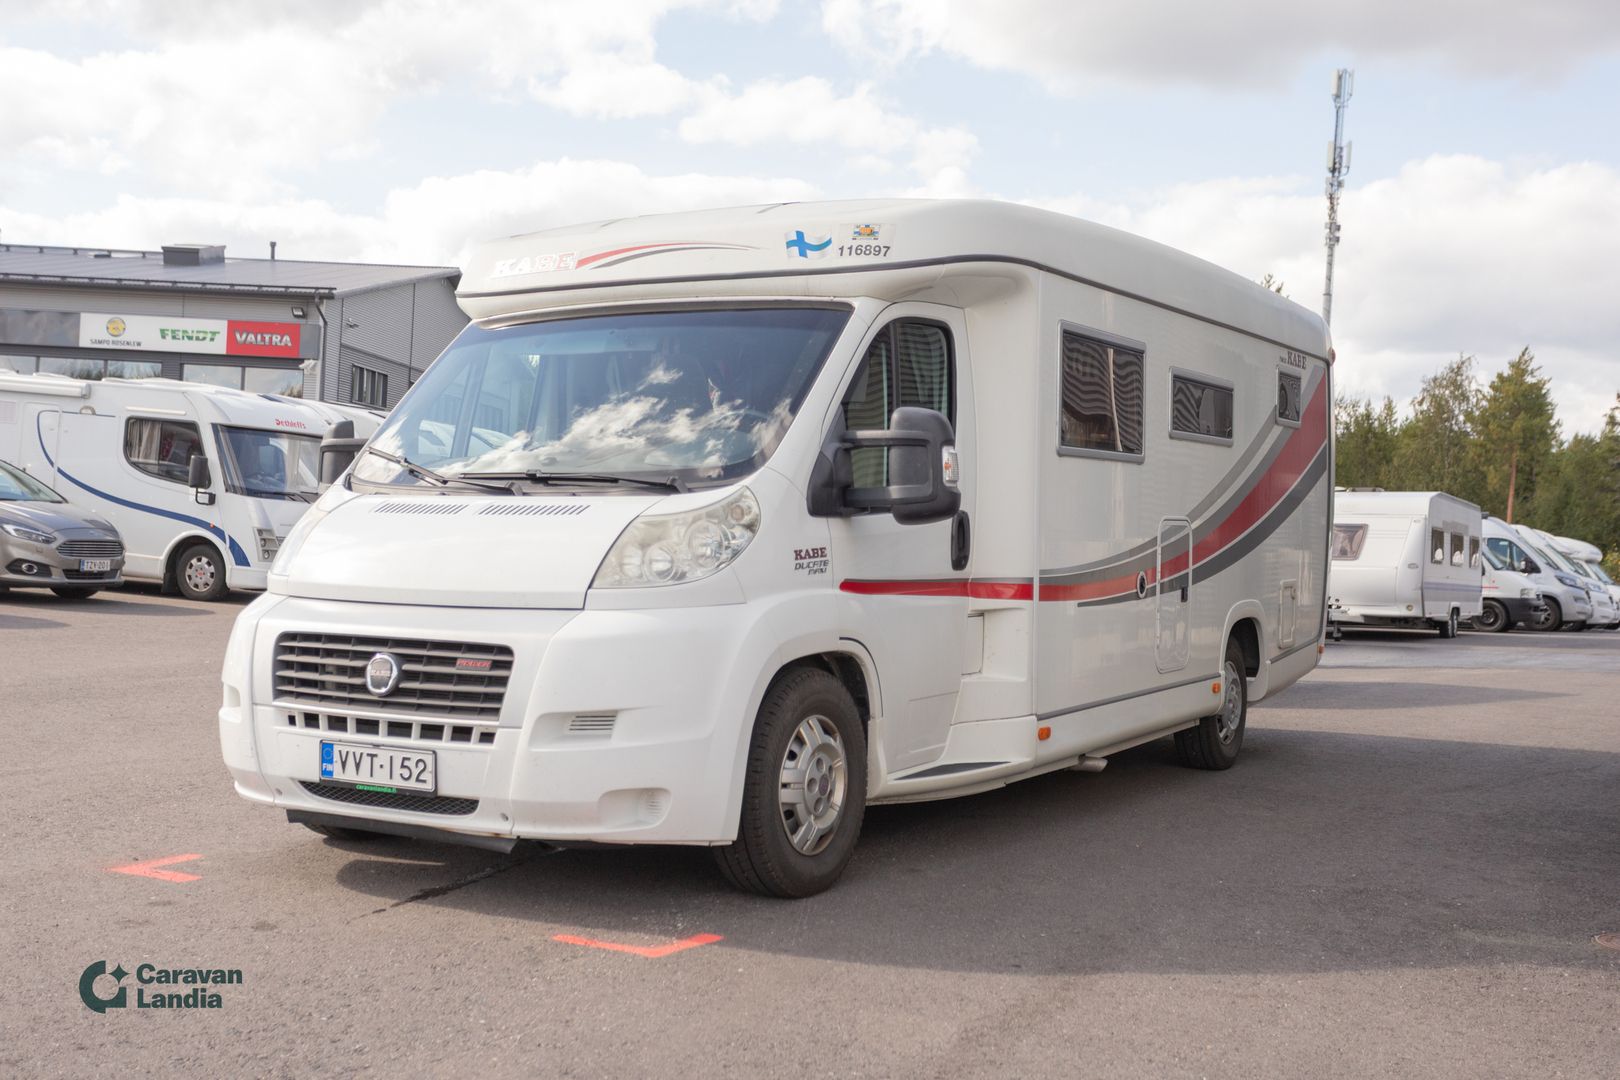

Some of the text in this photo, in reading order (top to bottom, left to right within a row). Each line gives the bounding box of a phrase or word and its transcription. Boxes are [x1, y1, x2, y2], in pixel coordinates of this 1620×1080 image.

[838, 244, 891, 257] 116897
[491, 252, 576, 277] KABE
[89, 338, 110, 346] SAMPO
[159, 328, 221, 342] FENDT
[234, 330, 292, 347] VALTRA
[1287, 351, 1306, 370] KABE
[793, 547, 827, 561] KABE
